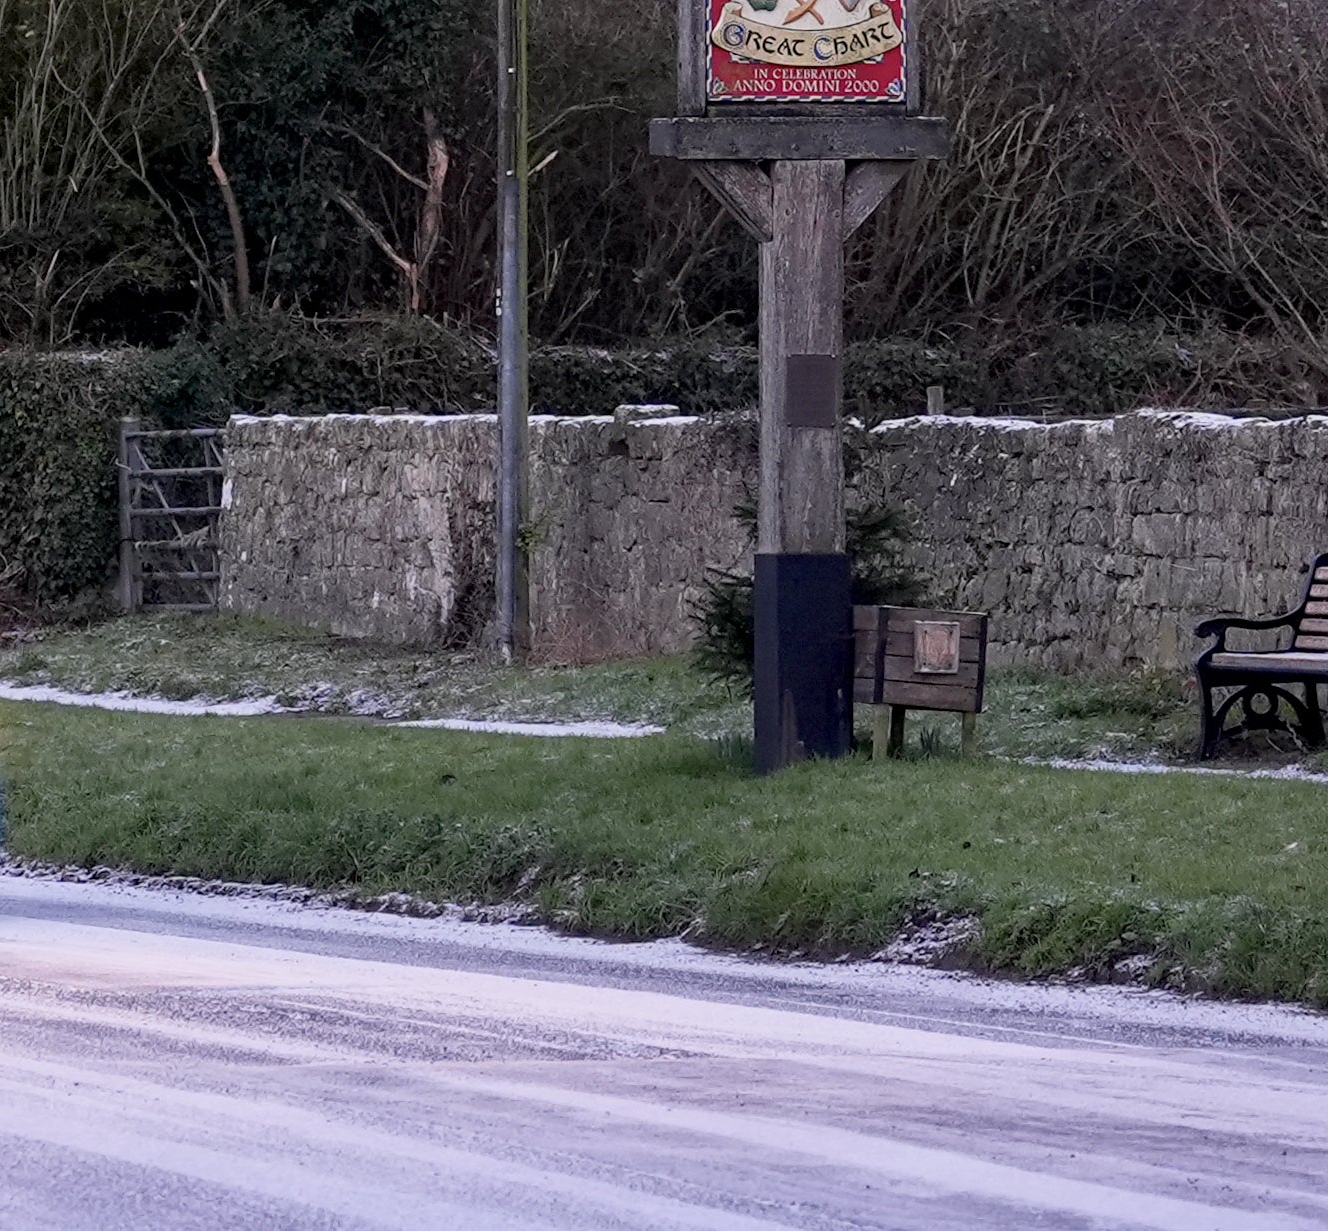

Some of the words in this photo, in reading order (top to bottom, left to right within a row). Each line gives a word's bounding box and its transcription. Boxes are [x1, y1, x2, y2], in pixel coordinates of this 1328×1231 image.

[722, 23, 805, 57] GREAT
[754, 69, 769, 80] IN
[772, 69, 857, 80] CELEBRATION
[733, 80, 775, 93] ANNO
[782, 80, 840, 93] DOMINI
[844, 79, 880, 93] 2000
